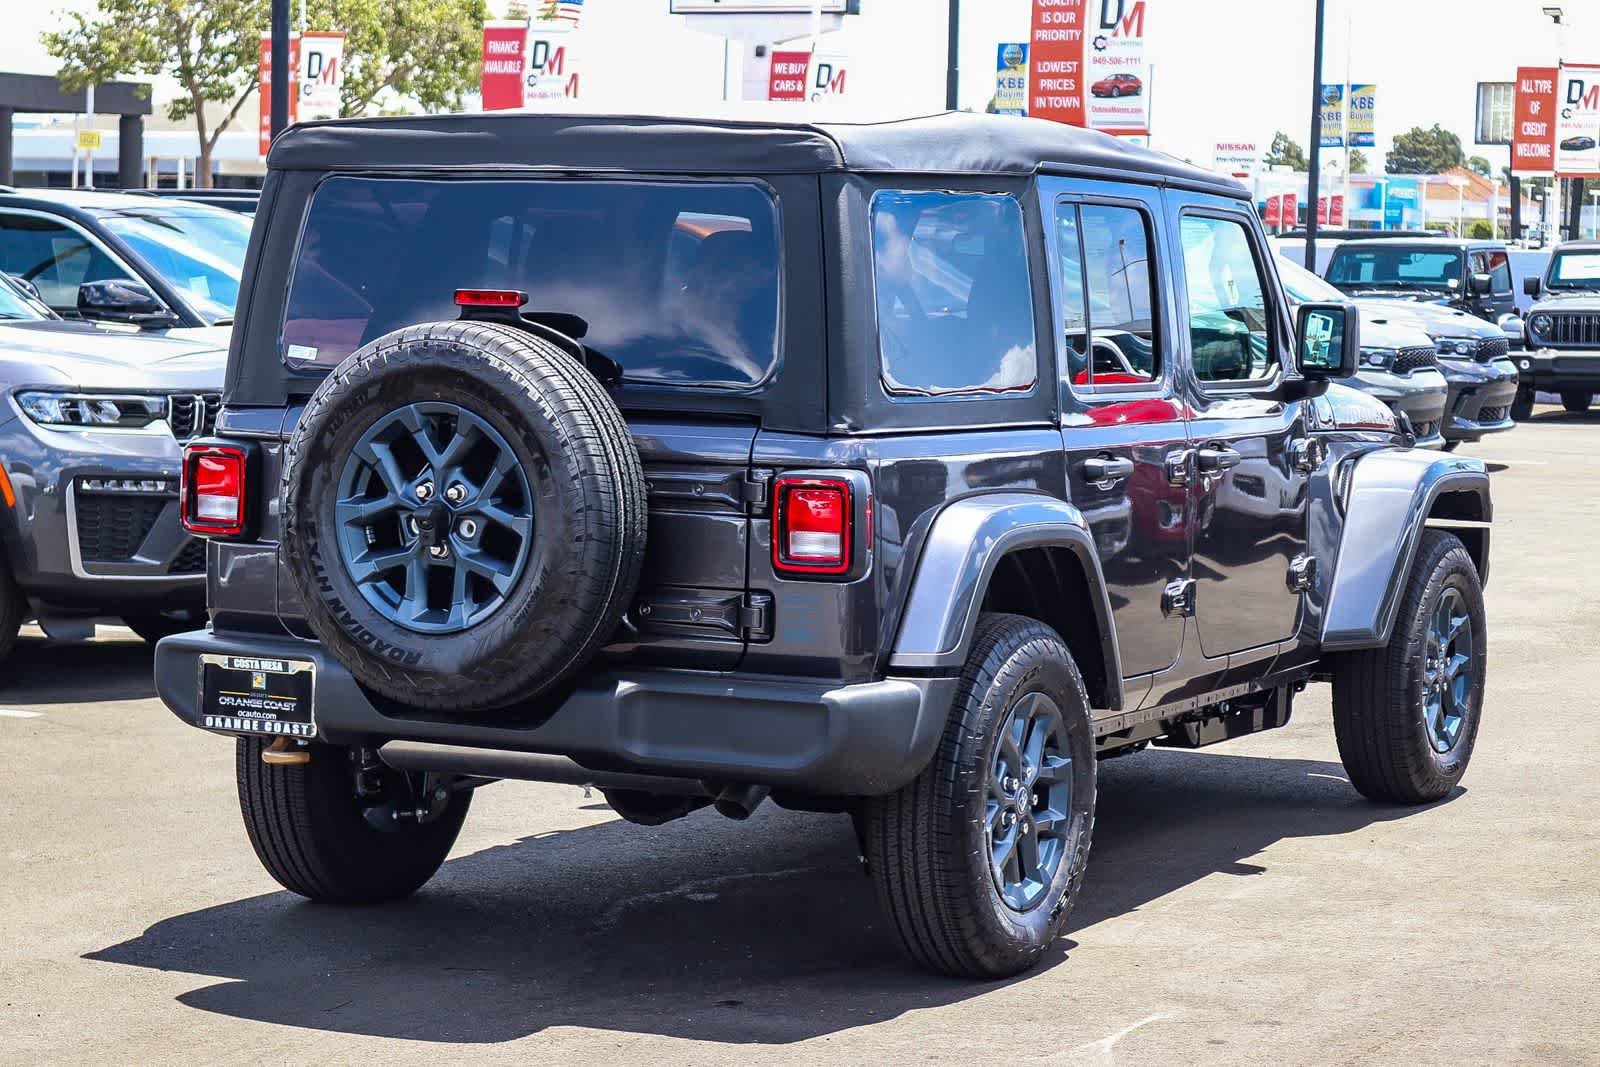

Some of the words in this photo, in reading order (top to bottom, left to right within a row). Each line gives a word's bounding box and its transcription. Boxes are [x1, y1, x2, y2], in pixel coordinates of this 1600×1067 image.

[1042, 12, 1051, 23] IS
[1054, 12, 1076, 23] OUR
[1036, 30, 1081, 41] PRIORITY
[488, 41, 520, 54] FINANCE
[532, 40, 565, 75] DM
[307, 51, 337, 85] DM
[484, 61, 521, 73] AVAILABLE
[775, 63, 788, 74] WE
[789, 63, 806, 75] BUY
[1038, 62, 1078, 73] LOWEST
[774, 80, 796, 92] CARS
[797, 80, 804, 91] &
[1040, 79, 1075, 91] PRICES
[1521, 80, 1535, 93] ALL
[1534, 80, 1552, 94] TYPE
[1036, 97, 1045, 107] IN
[1048, 97, 1080, 109] TOWN
[1351, 97, 1374, 109] KBB
[1530, 101, 1541, 115] OF
[1522, 123, 1547, 136] CREDIT
[1517, 144, 1550, 157] WELCOME
[328, 598, 424, 665] ROADIAN
[233, 659, 260, 669] COSTA
[261, 661, 283, 671] MESA
[218, 696, 263, 708] ORANGE
[263, 700, 297, 711] COAST
[237, 710, 277, 720] ocauto.com
[205, 716, 259, 730] ORANGE
[264, 722, 309, 735] COAST
